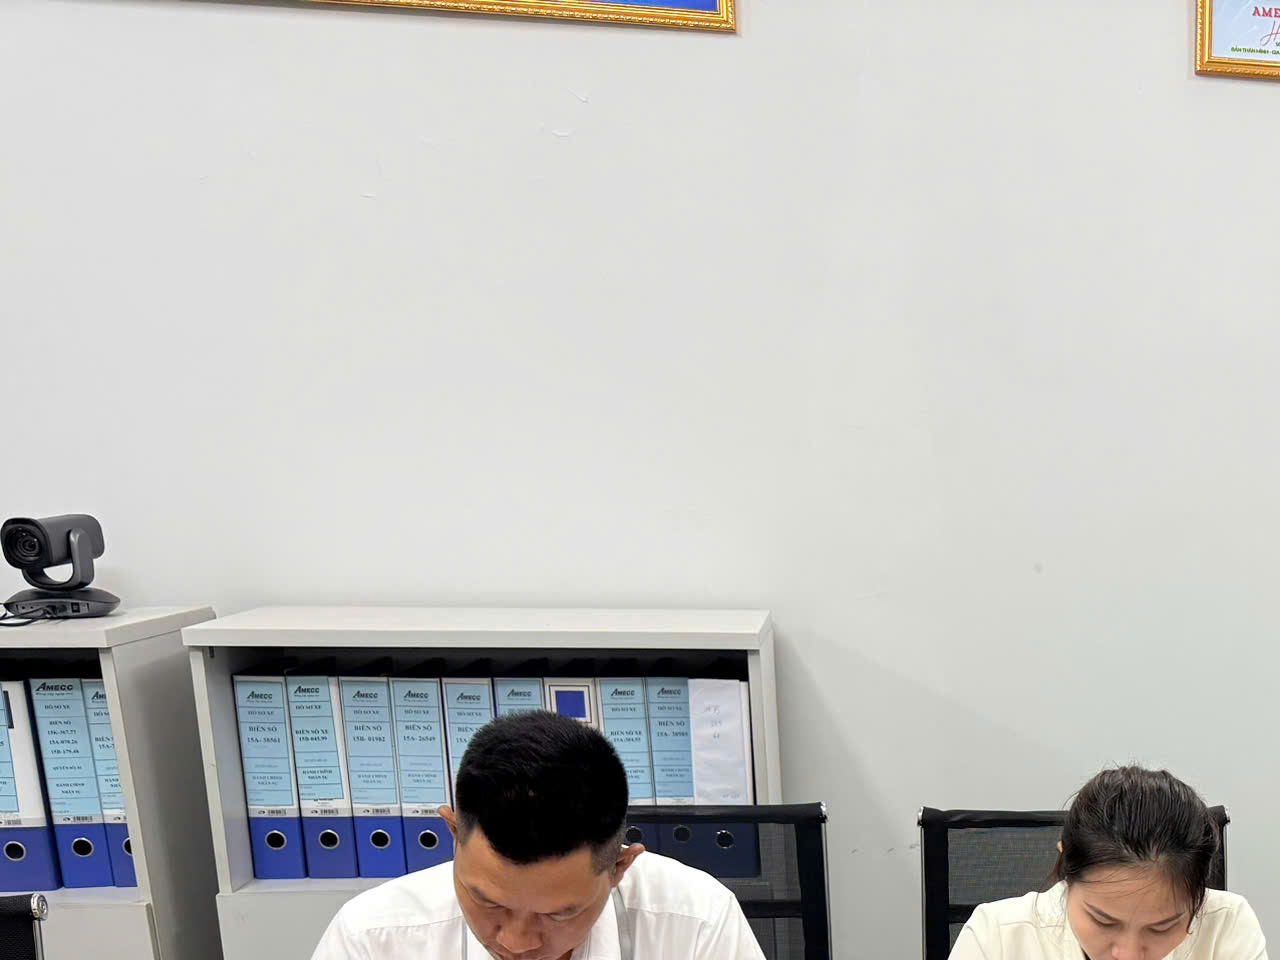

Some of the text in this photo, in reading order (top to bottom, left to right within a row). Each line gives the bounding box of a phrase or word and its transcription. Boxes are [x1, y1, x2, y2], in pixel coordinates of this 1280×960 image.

[35, 682, 73, 692] AMECC
[294, 685, 320, 694] AMECC
[247, 690, 273, 700] AMECC
[352, 690, 379, 699] AMECC
[404, 690, 428, 699] AMECC
[610, 688, 635, 697] AMECC
